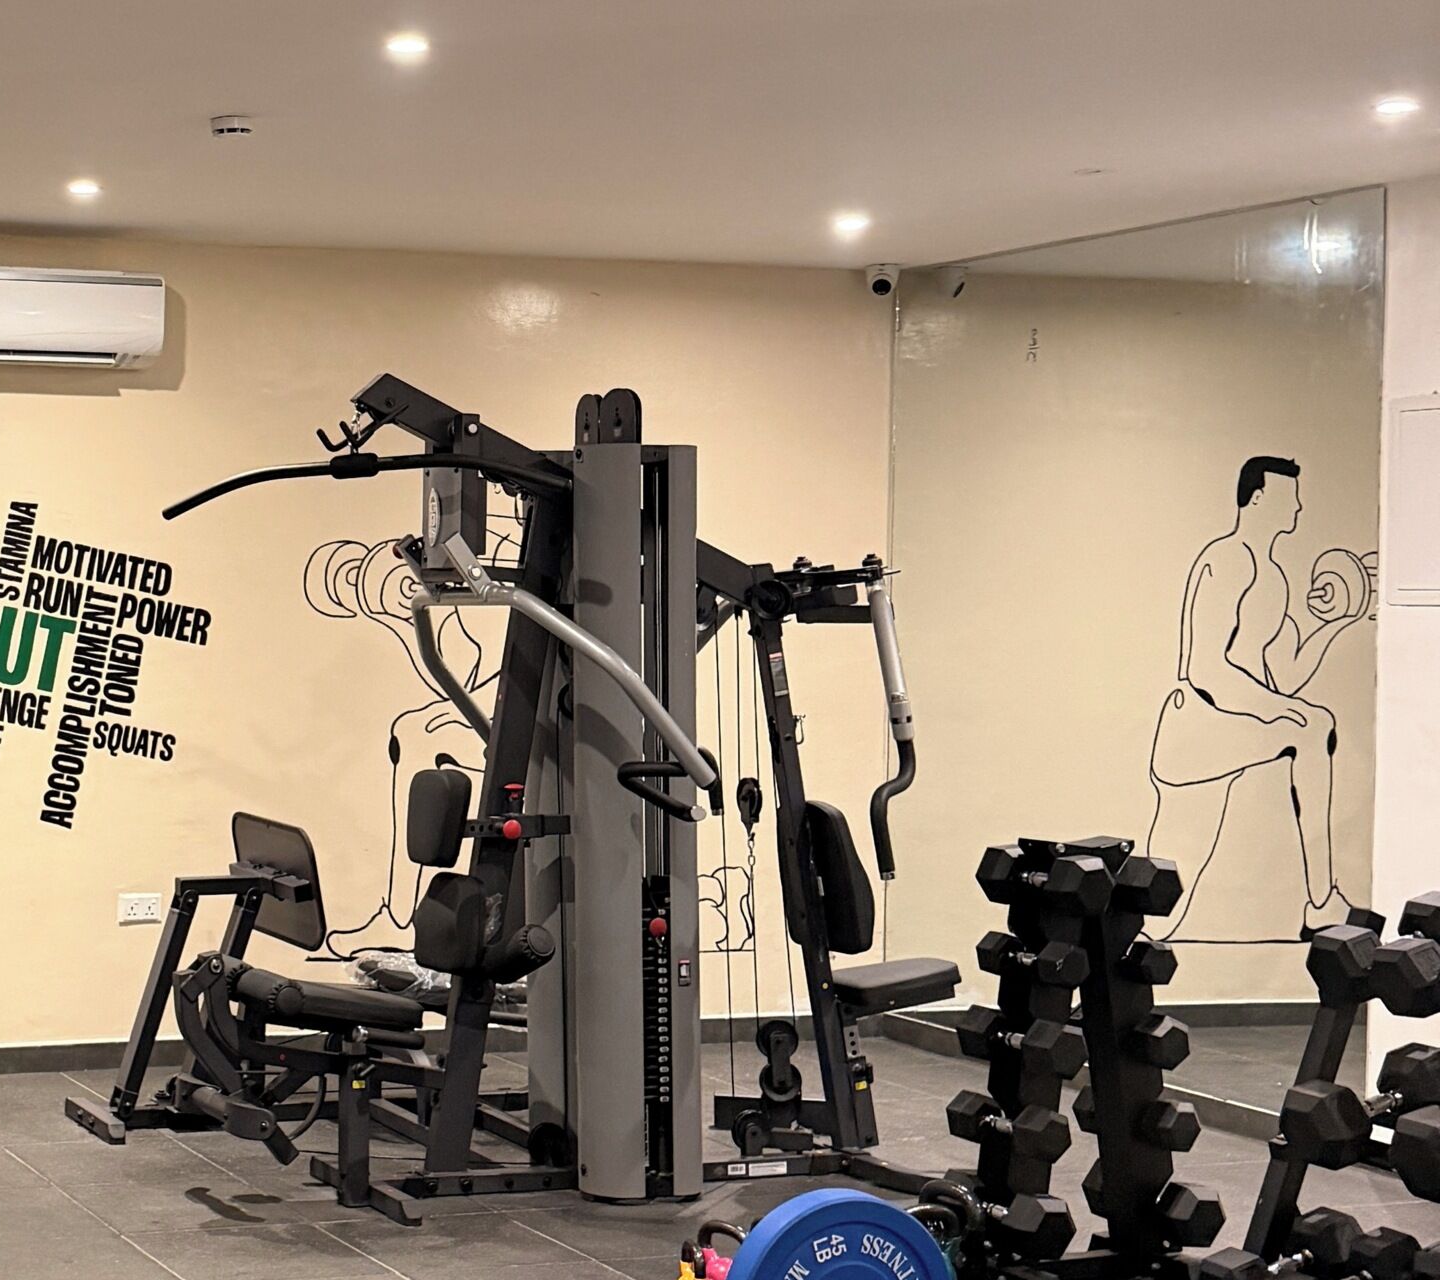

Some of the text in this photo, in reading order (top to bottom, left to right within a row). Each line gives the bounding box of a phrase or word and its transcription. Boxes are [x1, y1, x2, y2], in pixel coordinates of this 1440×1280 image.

[31, 535, 173, 597] MOTIVATED
[23, 572, 84, 618] RUN
[116, 592, 211, 646] POWER
[98, 633, 145, 717] TONED
[40, 586, 118, 829] ACCOMPLISHMENT
[92, 720, 176, 761] SQUATS
[812, 1236, 831, 1264] LB
[830, 1234, 847, 1257] 45
